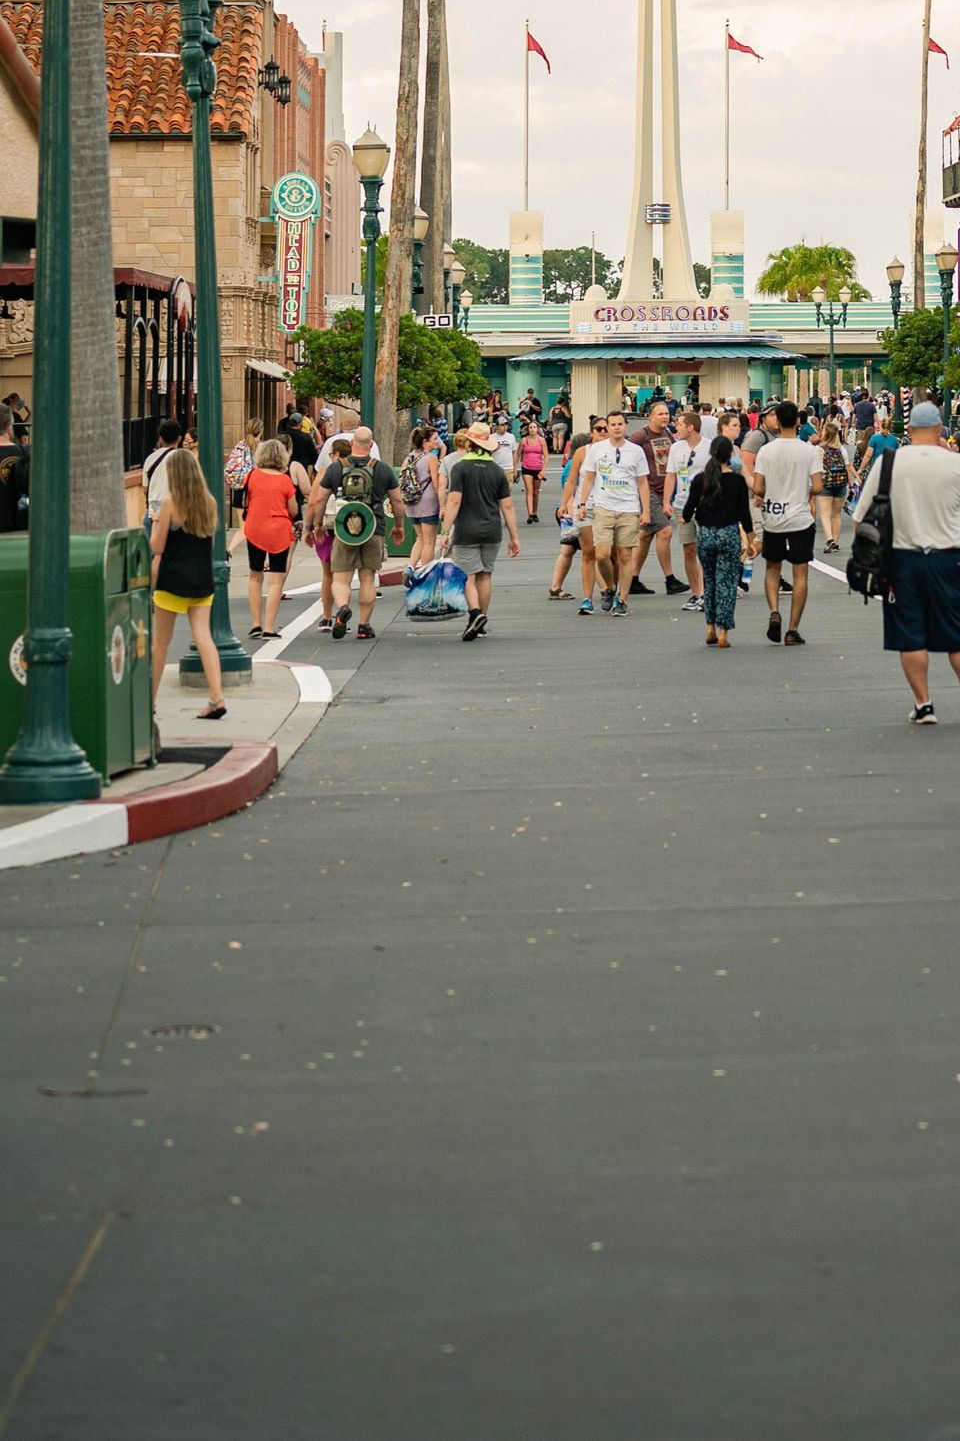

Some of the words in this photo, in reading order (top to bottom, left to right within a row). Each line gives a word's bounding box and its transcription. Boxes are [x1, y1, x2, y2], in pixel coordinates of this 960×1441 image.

[285, 286, 299, 324] TOE
[594, 305, 730, 322] CROSSROADS
[604, 323, 620, 331] OF
[633, 323, 659, 331] THE
[670, 322, 718, 331] WORLD
